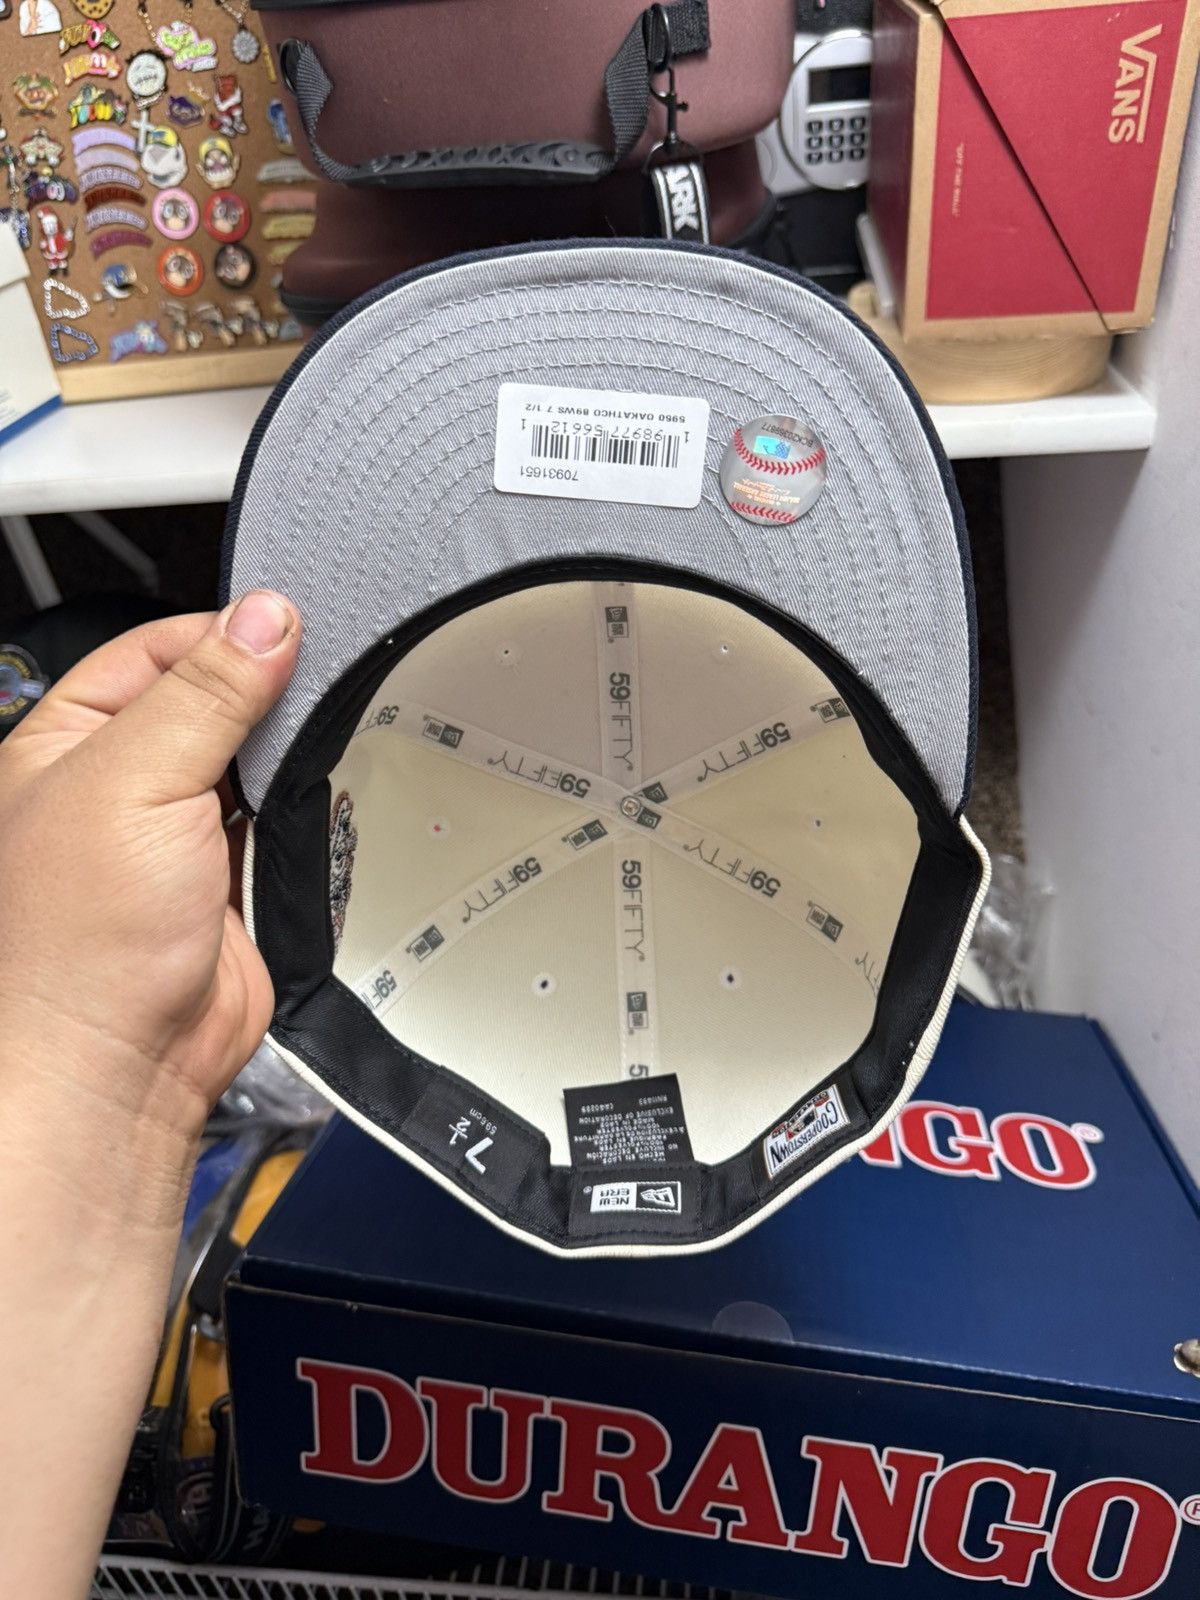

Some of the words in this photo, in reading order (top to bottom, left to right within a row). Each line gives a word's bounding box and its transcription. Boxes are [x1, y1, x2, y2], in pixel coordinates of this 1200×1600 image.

[1108, 24, 1162, 143] VANS
[525, 403, 541, 412] 1/2
[547, 405, 553, 414] 7
[558, 406, 590, 416] 89WS
[593, 409, 654, 421] OAKATHCO
[551, 421, 603, 438] 56612
[610, 426, 664, 442] 98977
[520, 465, 580, 482] 70931651
[609, 672, 635, 770] 59FIFTY
[699, 722, 792, 781] 59FIFTY
[492, 750, 591, 799] 59FIFTY
[688, 838, 782, 899] 59FIFTY
[466, 856, 543, 921] 59FIFTY
[621, 859, 644, 957] 59FIFTY
[579, 1113, 622, 1124] DECORATION
[770, 1101, 839, 1168] COOPERSTOWN
[464, 1137, 494, 1175] 7
[599, 1197, 630, 1206] NEW
[600, 1188, 630, 1197] ERA
[297, 1357, 1182, 1600] DURANGO
